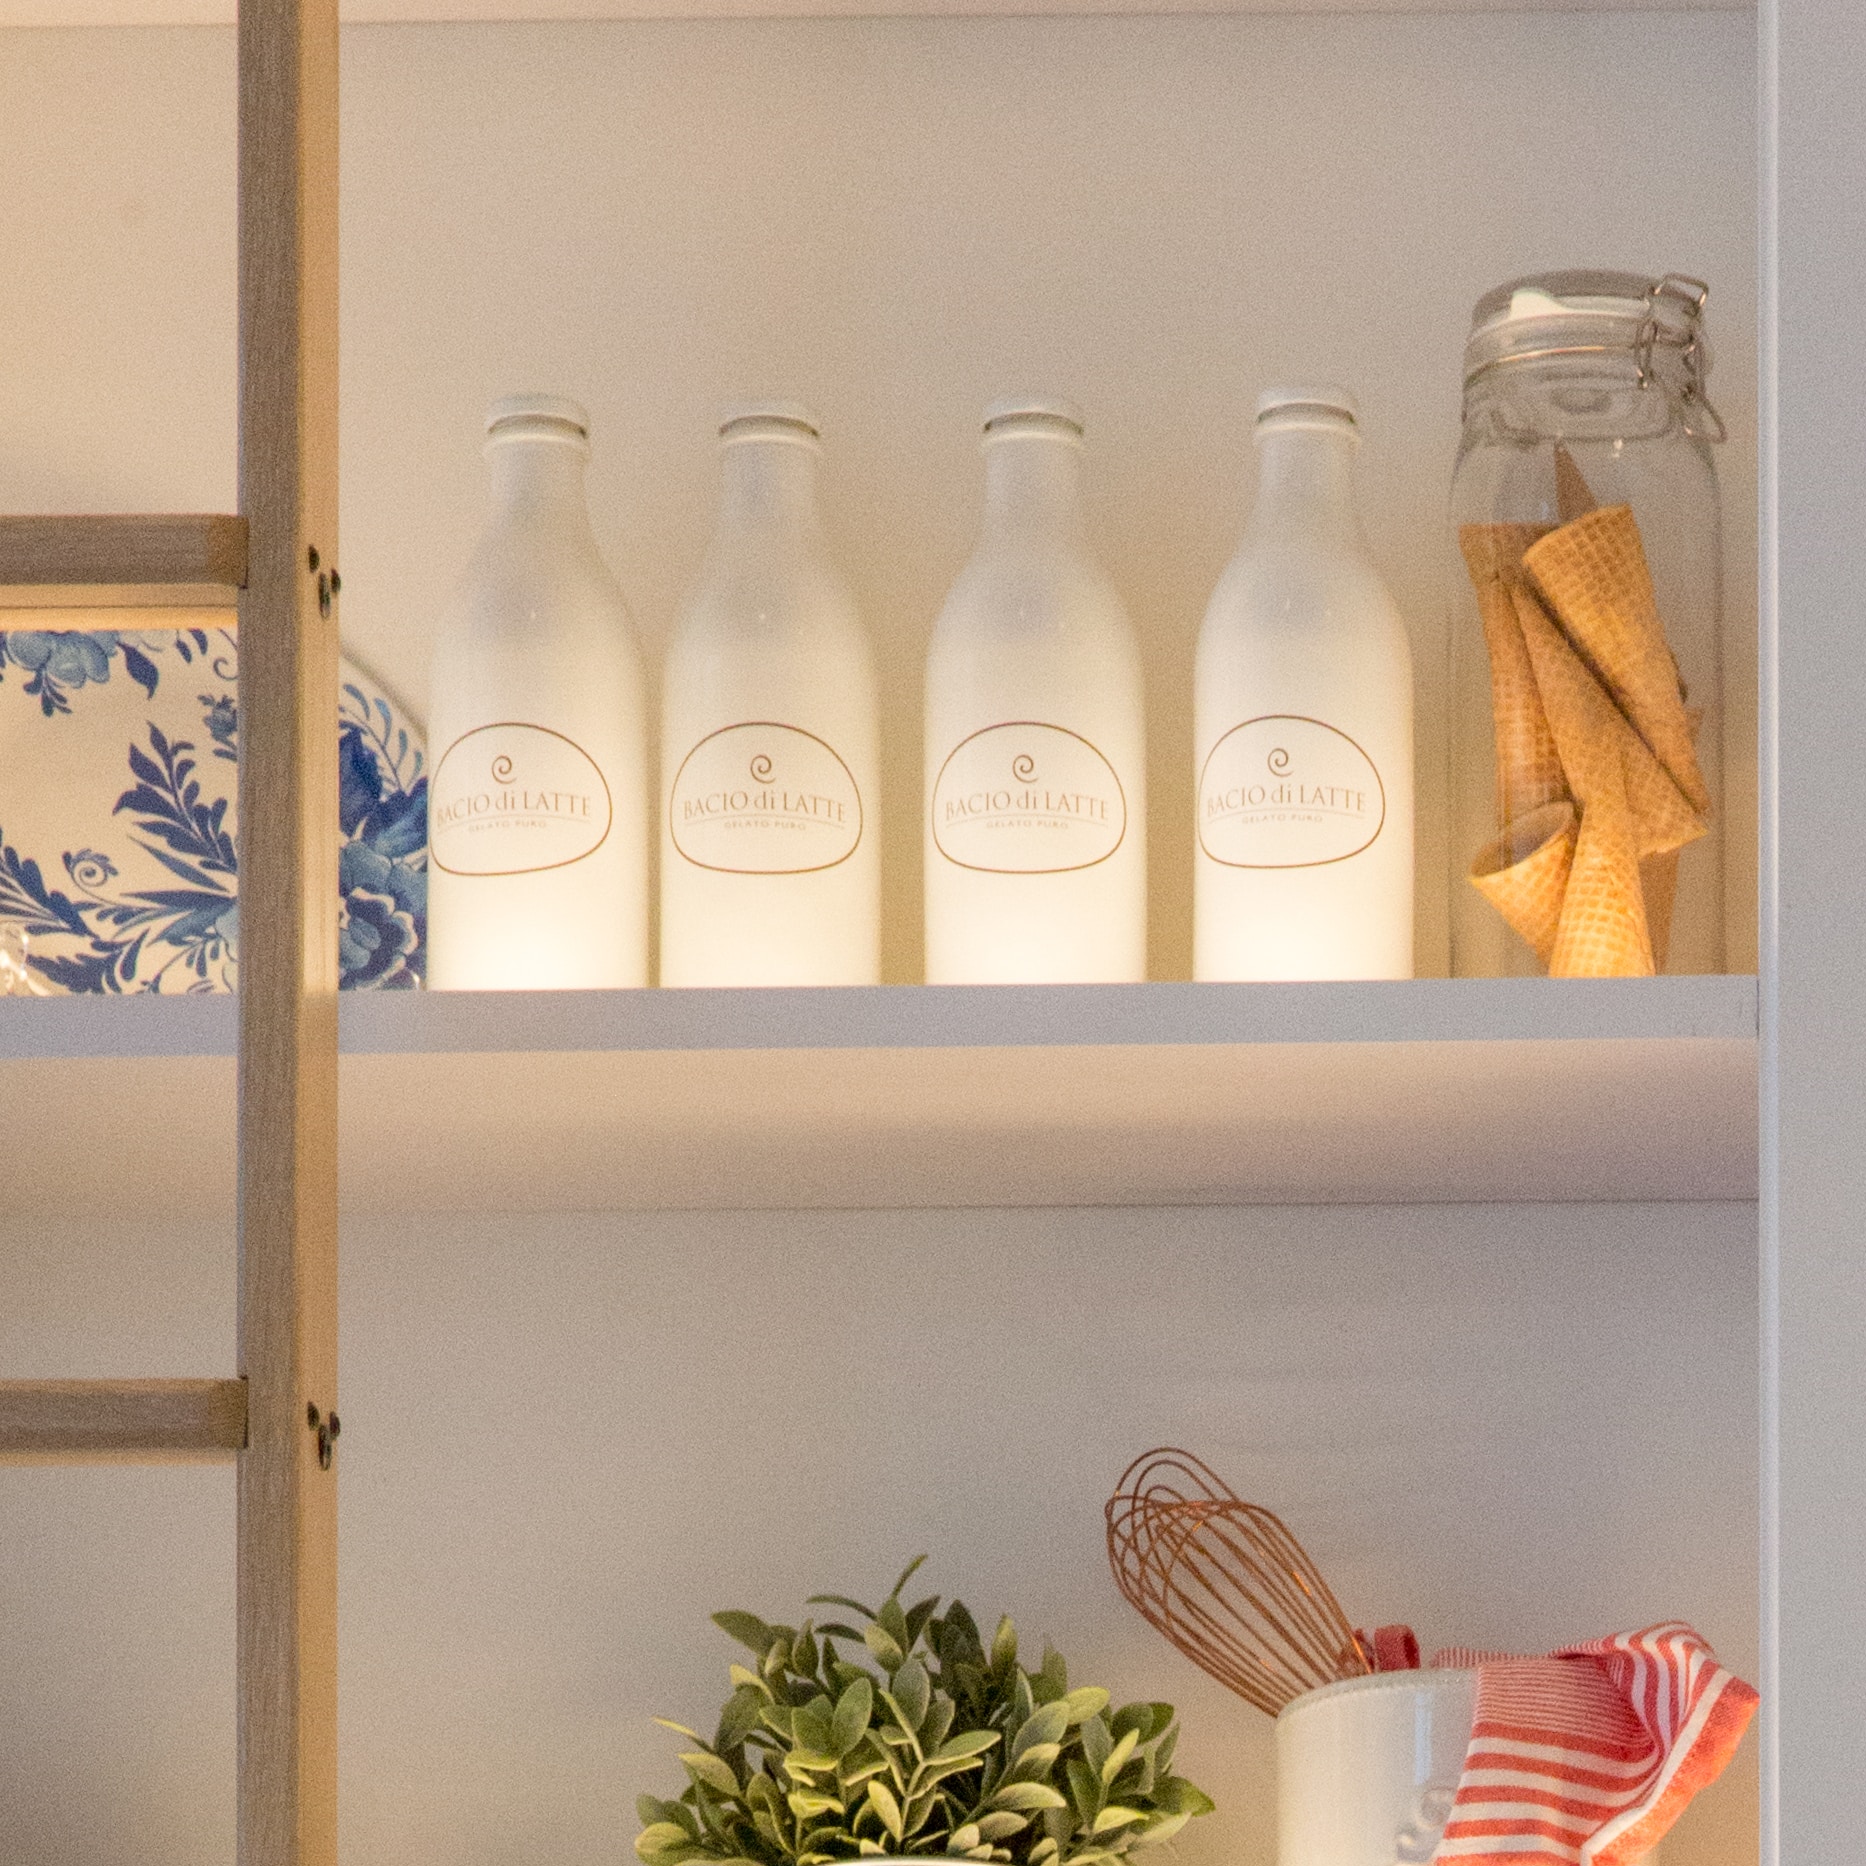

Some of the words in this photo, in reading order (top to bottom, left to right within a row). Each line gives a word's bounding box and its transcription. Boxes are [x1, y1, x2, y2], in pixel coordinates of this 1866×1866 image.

[495, 789, 515, 810] di
[684, 790, 748, 820] BACIO
[754, 789, 776, 810] di
[783, 792, 846, 822] LATTE
[946, 790, 1012, 821] BACIO
[1016, 788, 1037, 810] di
[1045, 791, 1109, 820] LATTE
[1207, 785, 1266, 818] BACIO
[1271, 783, 1292, 804] di
[1300, 784, 1366, 812] LATTE
